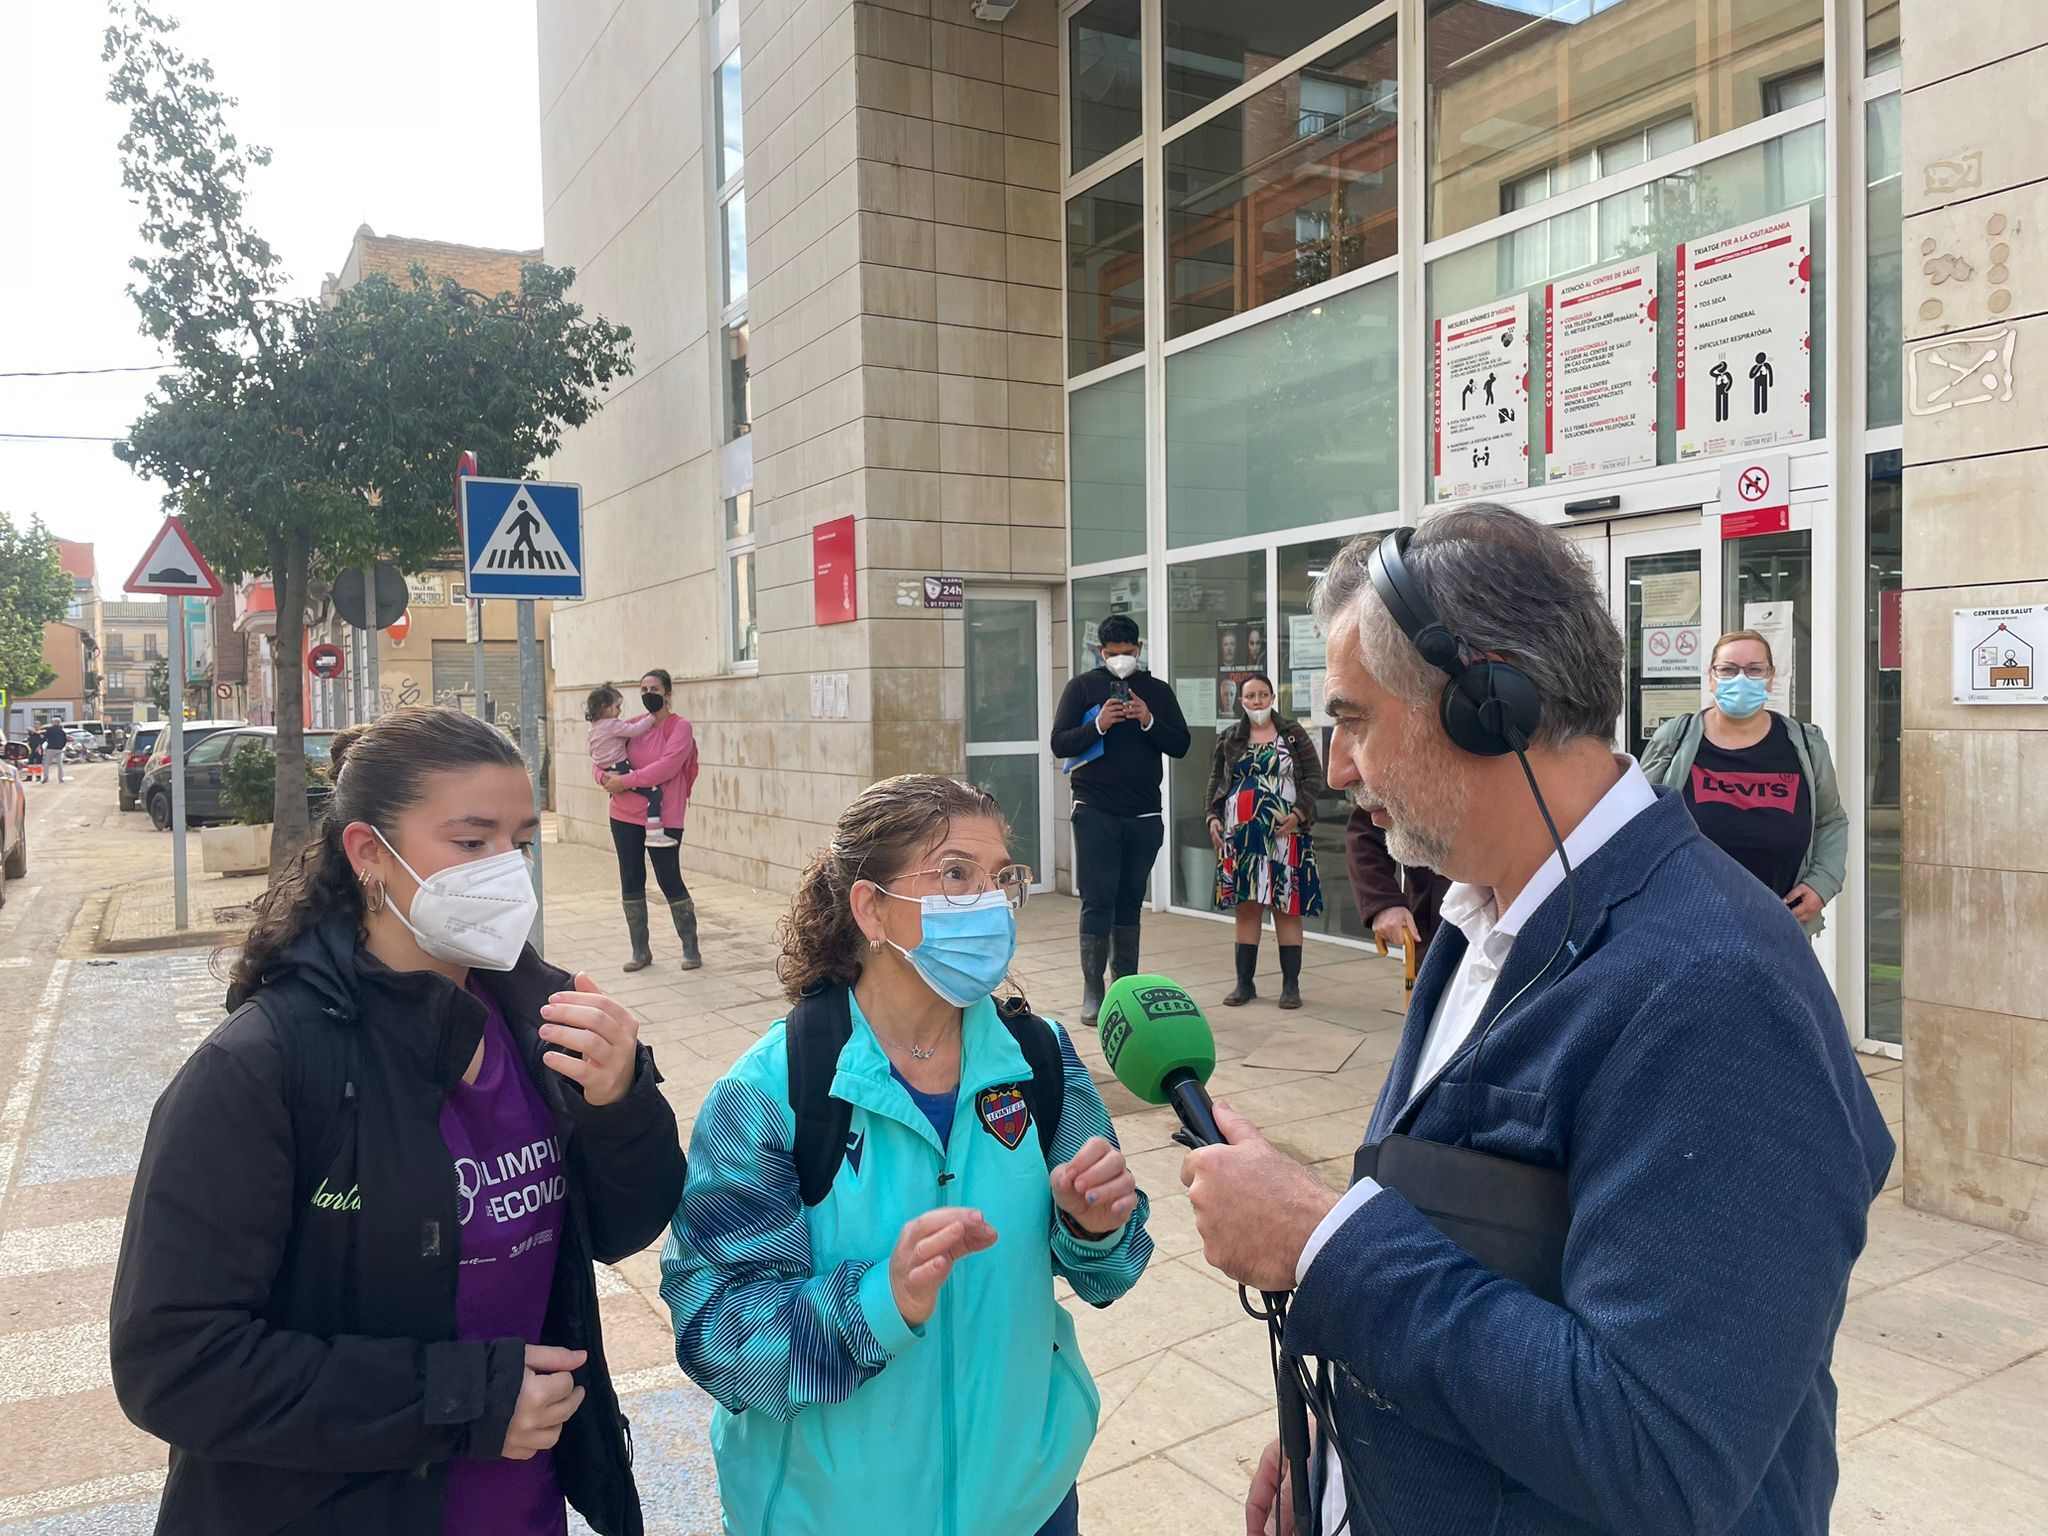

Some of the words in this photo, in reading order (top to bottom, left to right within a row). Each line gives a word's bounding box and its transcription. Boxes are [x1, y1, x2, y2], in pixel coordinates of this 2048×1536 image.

[1694, 243, 1720, 256] TRIATGE
[1721, 239, 1733, 248] PER
[1750, 222, 1791, 239] CIUTADANIA
[1561, 283, 1584, 295] ATENCIÓ
[1592, 274, 1613, 286] CENTRE
[1614, 272, 1621, 280] DE
[1622, 266, 1640, 277] SALUT
[1699, 273, 1733, 287] CALENTURA
[1699, 299, 1711, 308] TOS
[1711, 296, 1727, 305] SECA
[1564, 311, 1593, 324] CONSULTAR
[1699, 317, 1729, 330] MALESTAR
[1729, 309, 1756, 322] GENERAL
[1589, 347, 1608, 356] CENTRE
[1616, 340, 1632, 349] SALUT
[1699, 338, 1730, 351] DIFICULTAT
[1582, 354, 1607, 365] CONTRARI
[1589, 379, 1608, 389] CENTRE
[1610, 381, 1632, 390] EXCEPTE
[1573, 423, 1589, 431] TEMES
[943, 585, 962, 595] 24h
[1973, 609, 1999, 617] CENTRE
[2010, 607, 2033, 615] SALUT
[1145, 991, 1183, 1000] ONDA
[1154, 1002, 1190, 1012] CERO
[990, 1105, 1013, 1120] LEVANTE
